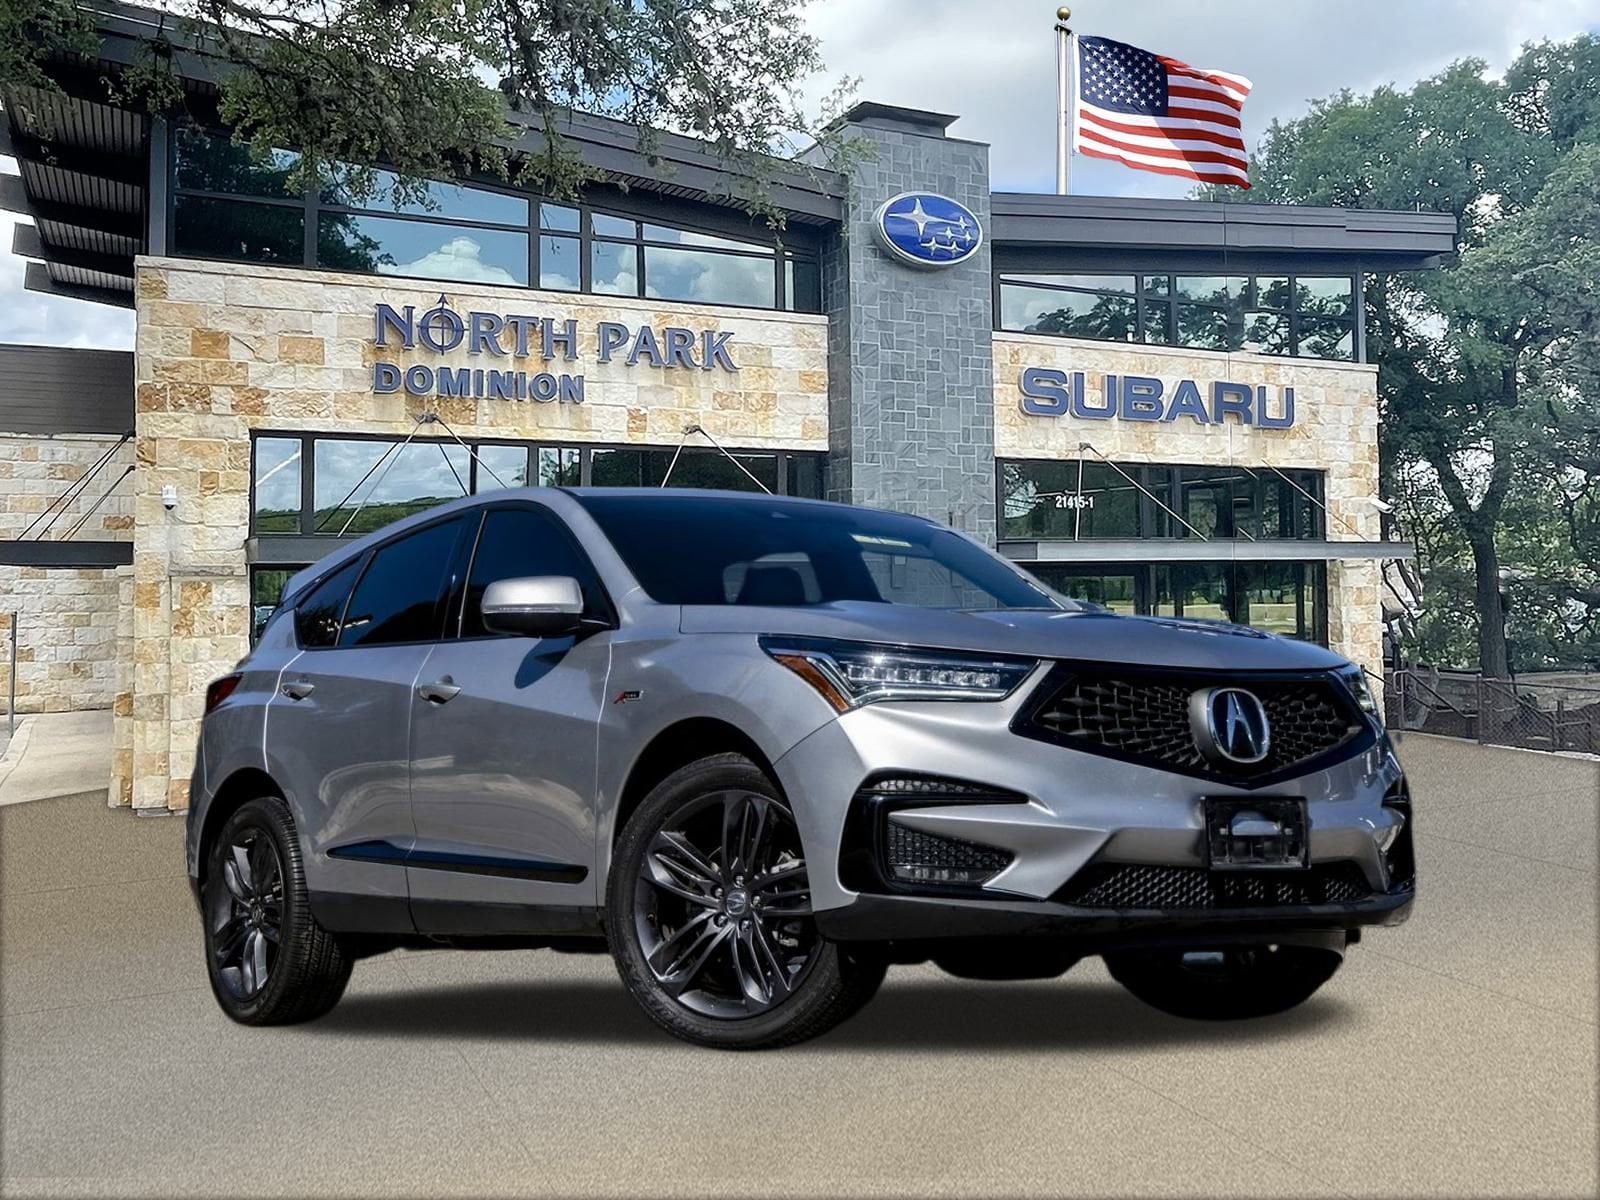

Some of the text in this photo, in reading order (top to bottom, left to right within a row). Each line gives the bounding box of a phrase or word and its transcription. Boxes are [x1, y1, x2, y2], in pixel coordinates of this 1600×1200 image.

[374, 299, 742, 373] NORTH PARK
[373, 361, 585, 403] DOMINION
[1019, 367, 1294, 429] SUBARU
